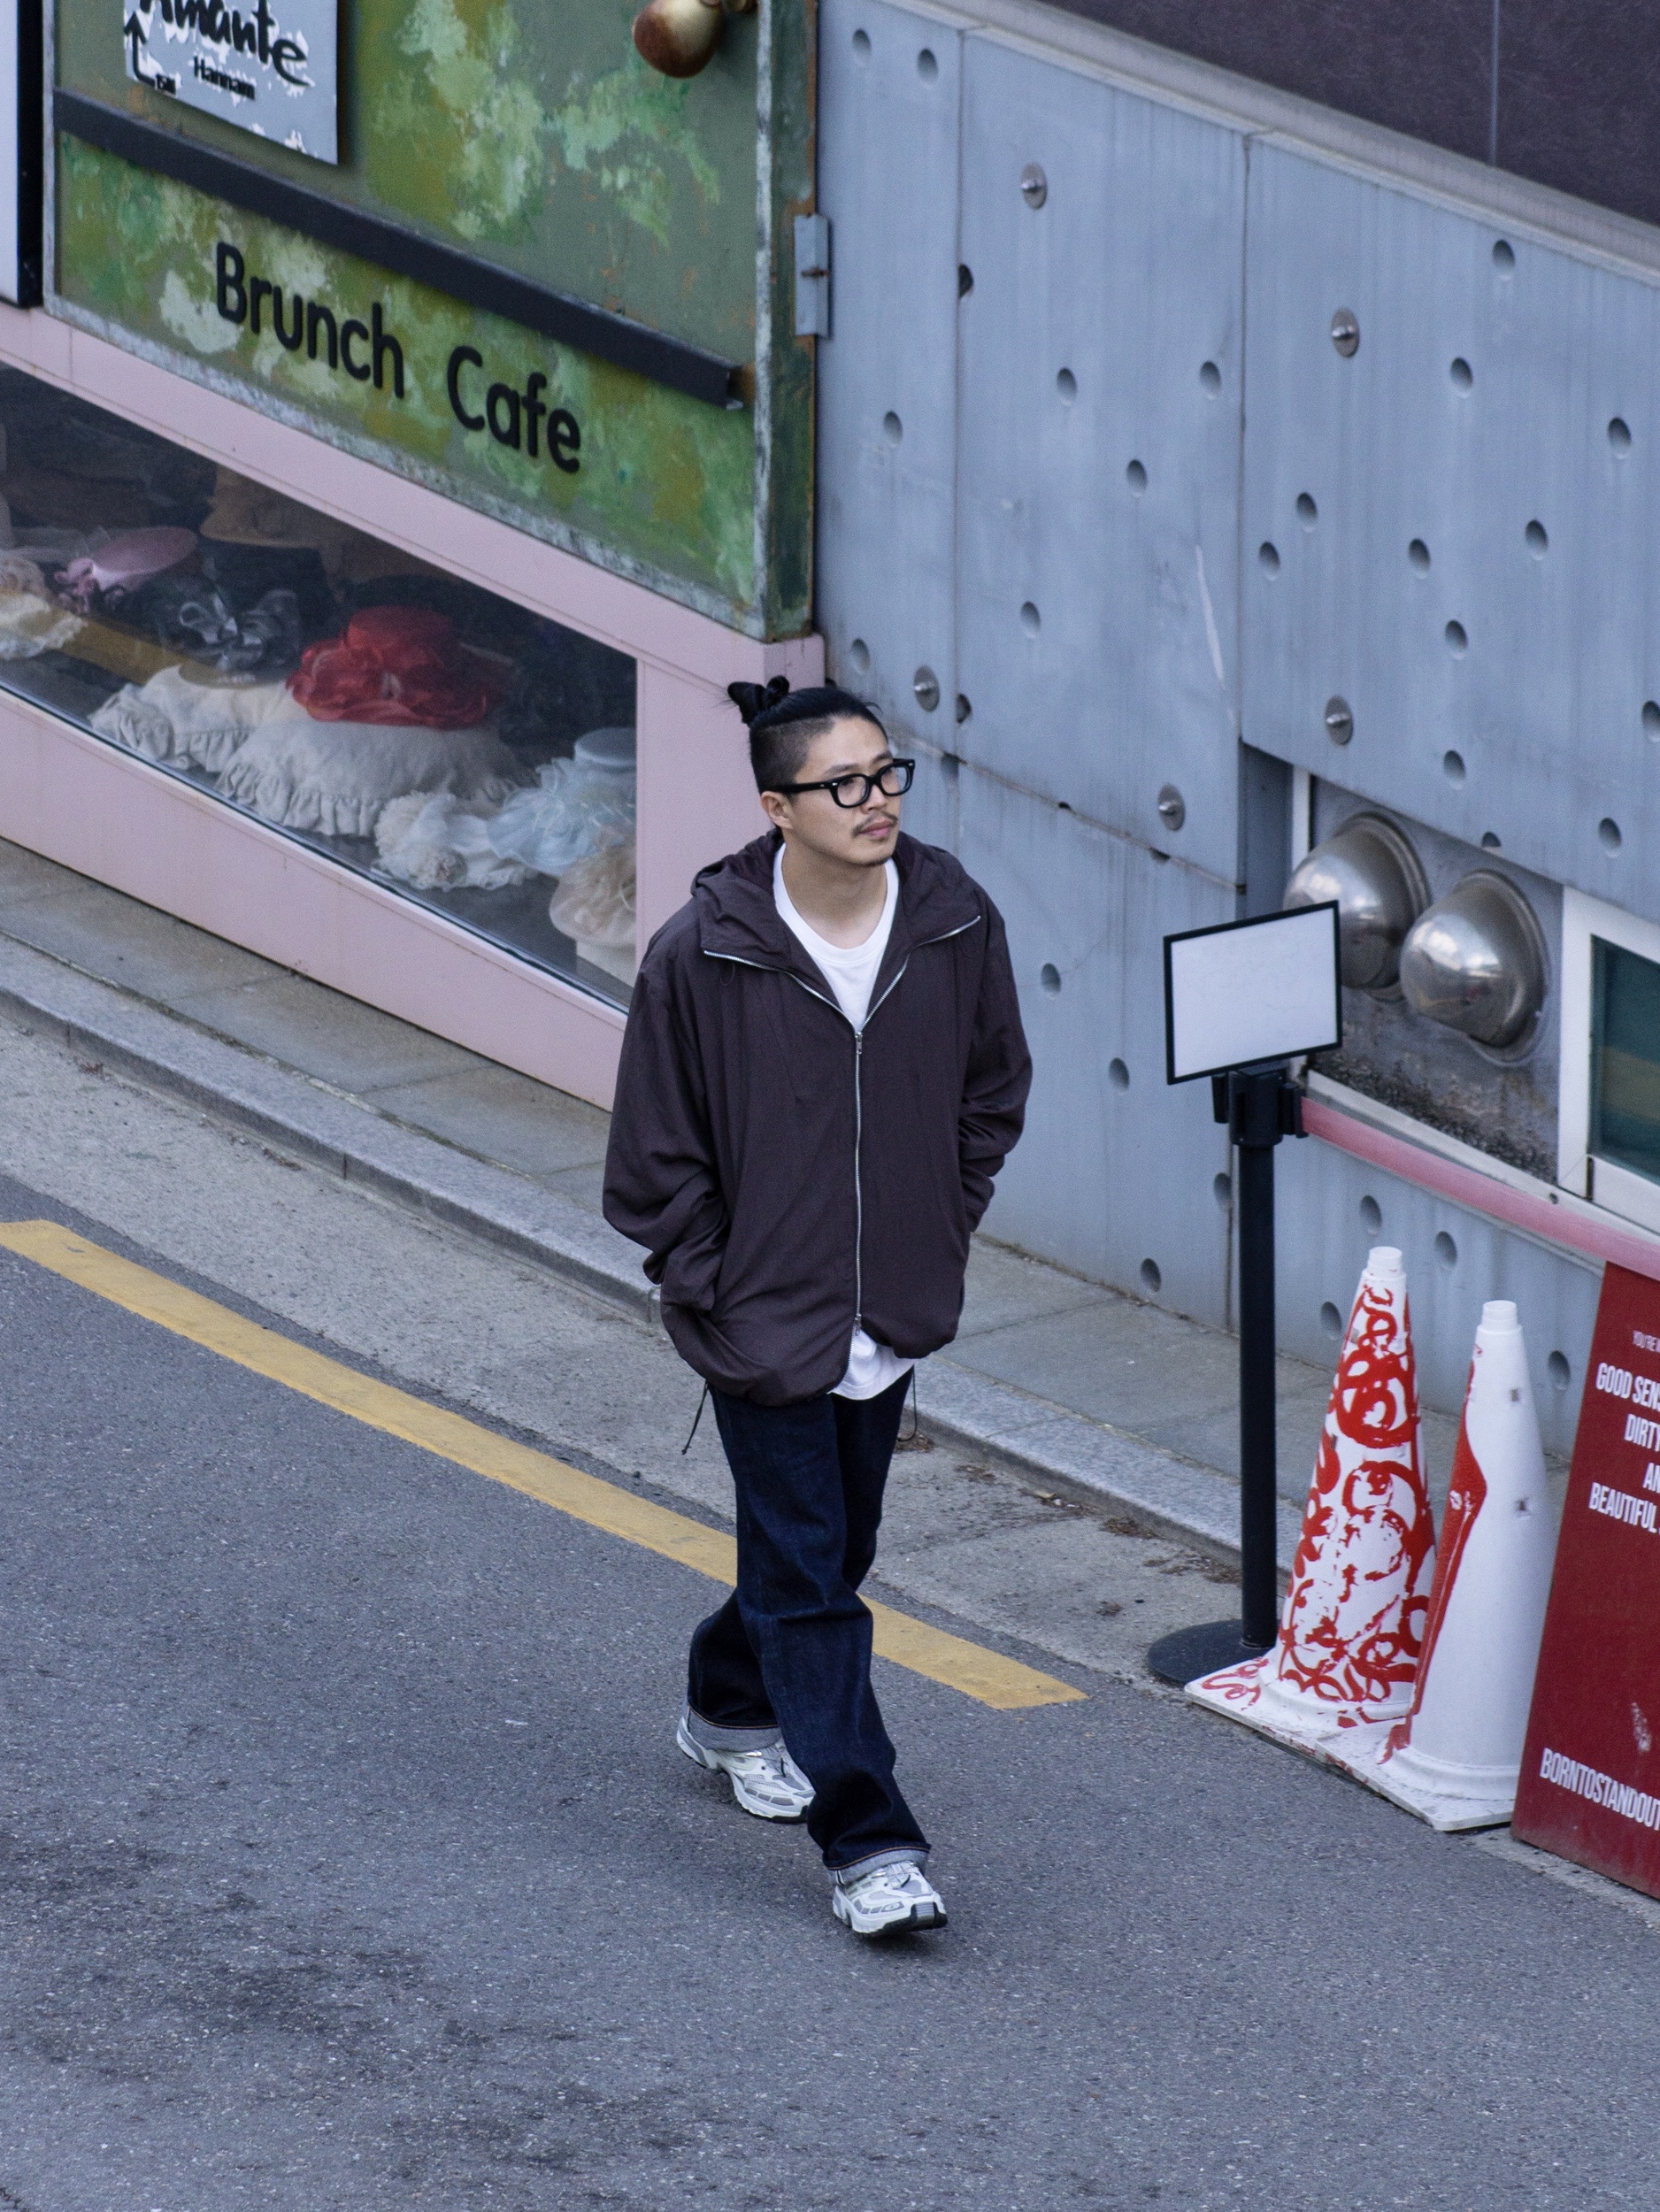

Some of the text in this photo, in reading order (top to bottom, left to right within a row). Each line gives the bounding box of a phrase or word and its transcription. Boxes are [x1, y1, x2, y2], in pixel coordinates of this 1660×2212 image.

[194, 56, 255, 100] Hannam
[216, 242, 580, 473] Brunch Cafe
[1595, 1362, 1633, 1399] GOOD
[1540, 1747, 1660, 1831] BORNTOSTANDOUT
